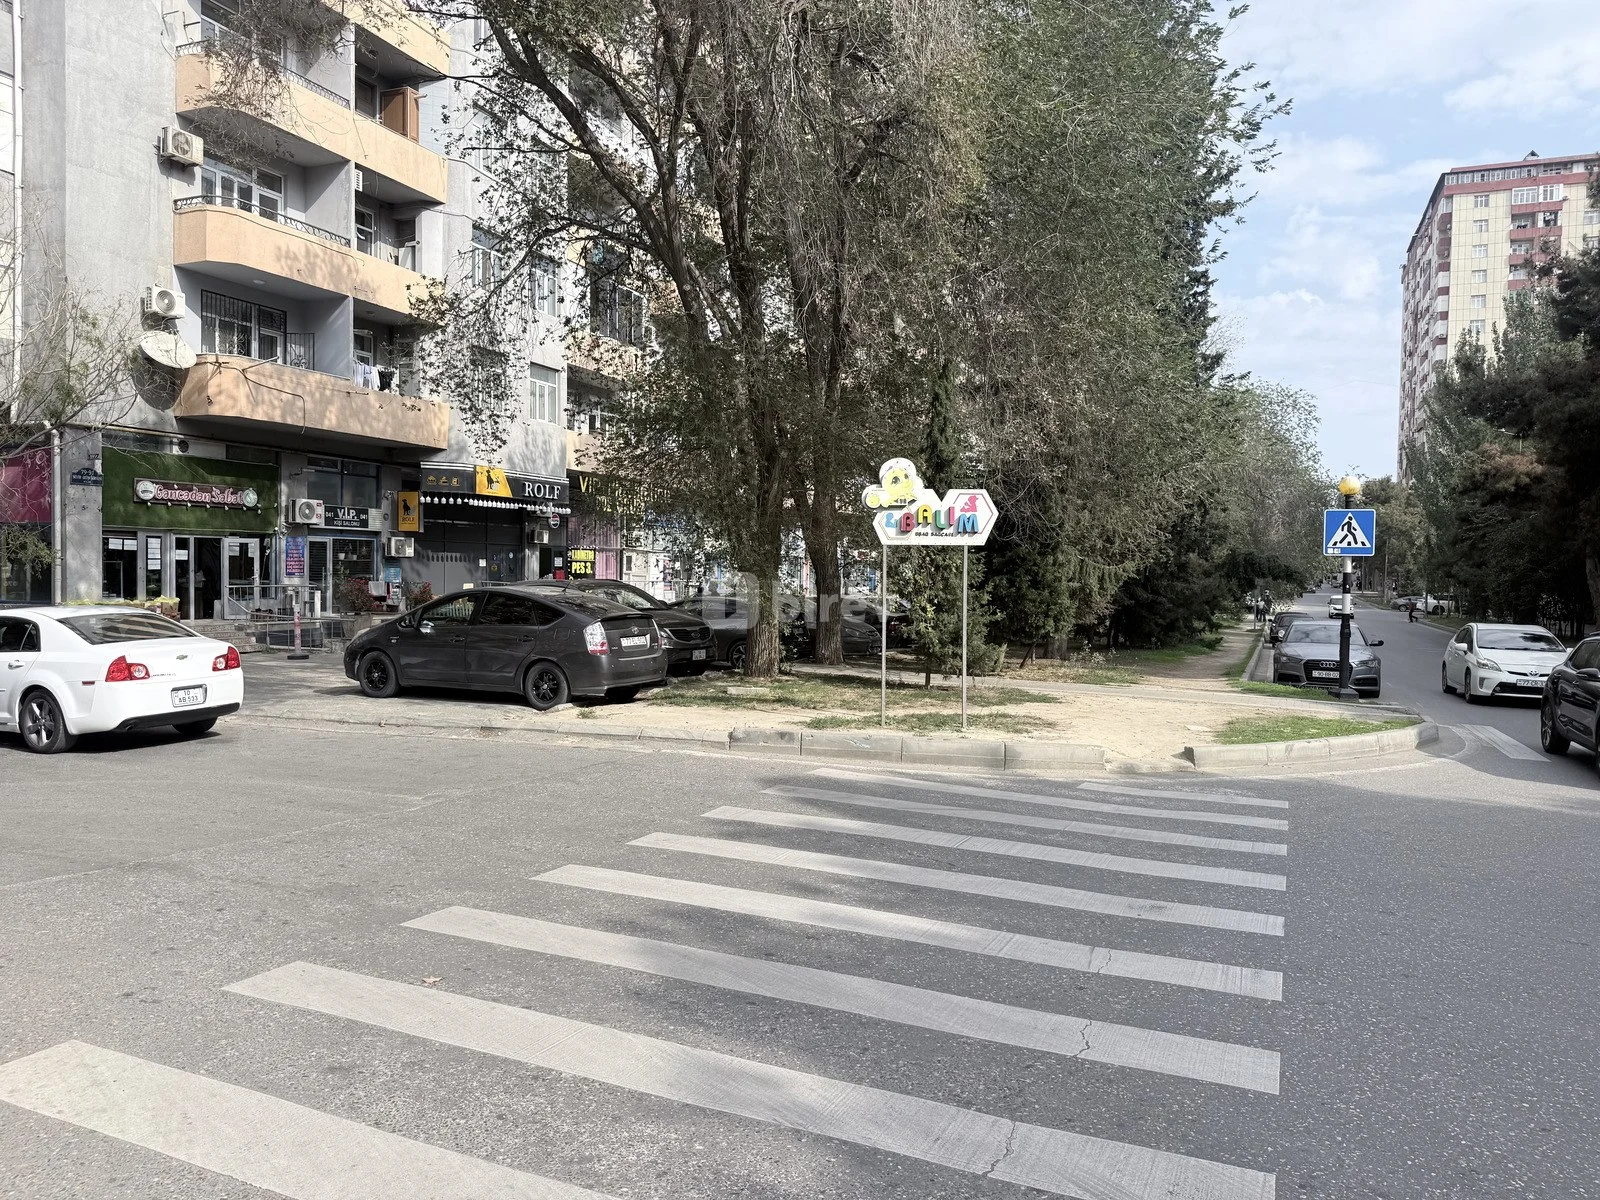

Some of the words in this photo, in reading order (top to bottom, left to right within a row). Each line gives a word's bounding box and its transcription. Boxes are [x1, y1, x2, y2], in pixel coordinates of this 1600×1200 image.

[524, 481, 561, 499] ROLF
[337, 507, 358, 520] V.I.P.
[901, 504, 979, 534] BALIM
[571, 561, 586, 574] PES
